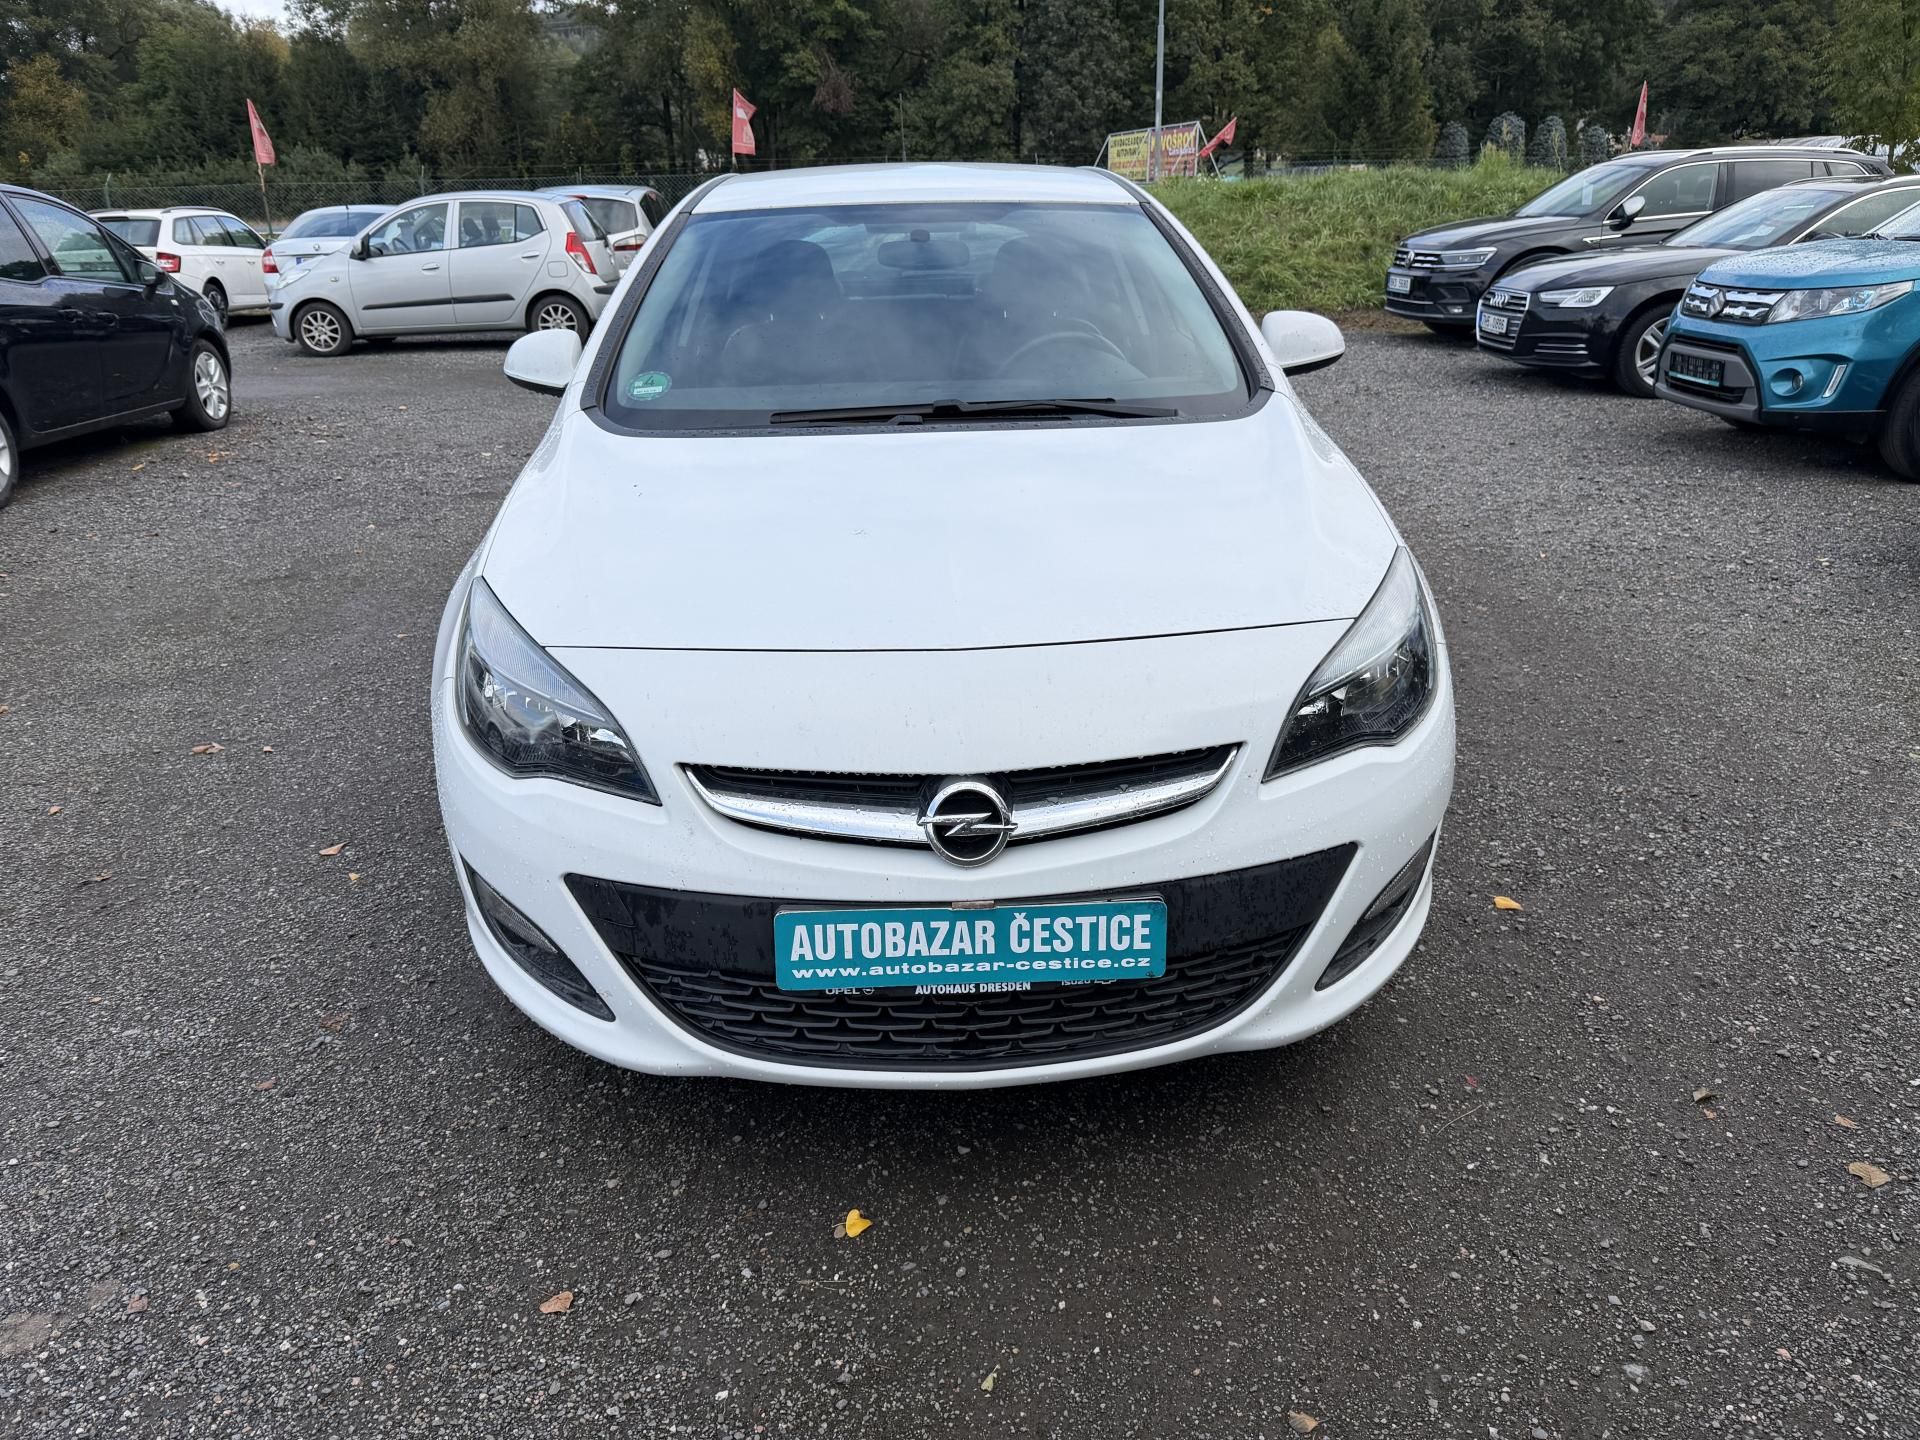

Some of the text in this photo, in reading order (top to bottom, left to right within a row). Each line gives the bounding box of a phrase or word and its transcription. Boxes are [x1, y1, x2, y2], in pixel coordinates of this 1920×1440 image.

[790, 912, 1151, 961] AUTOBAZAR ČESTICE
[791, 955, 1151, 979] www.autobazar-cestice.cz
[914, 981, 1031, 995] AUTOHAUS DRESDEN
